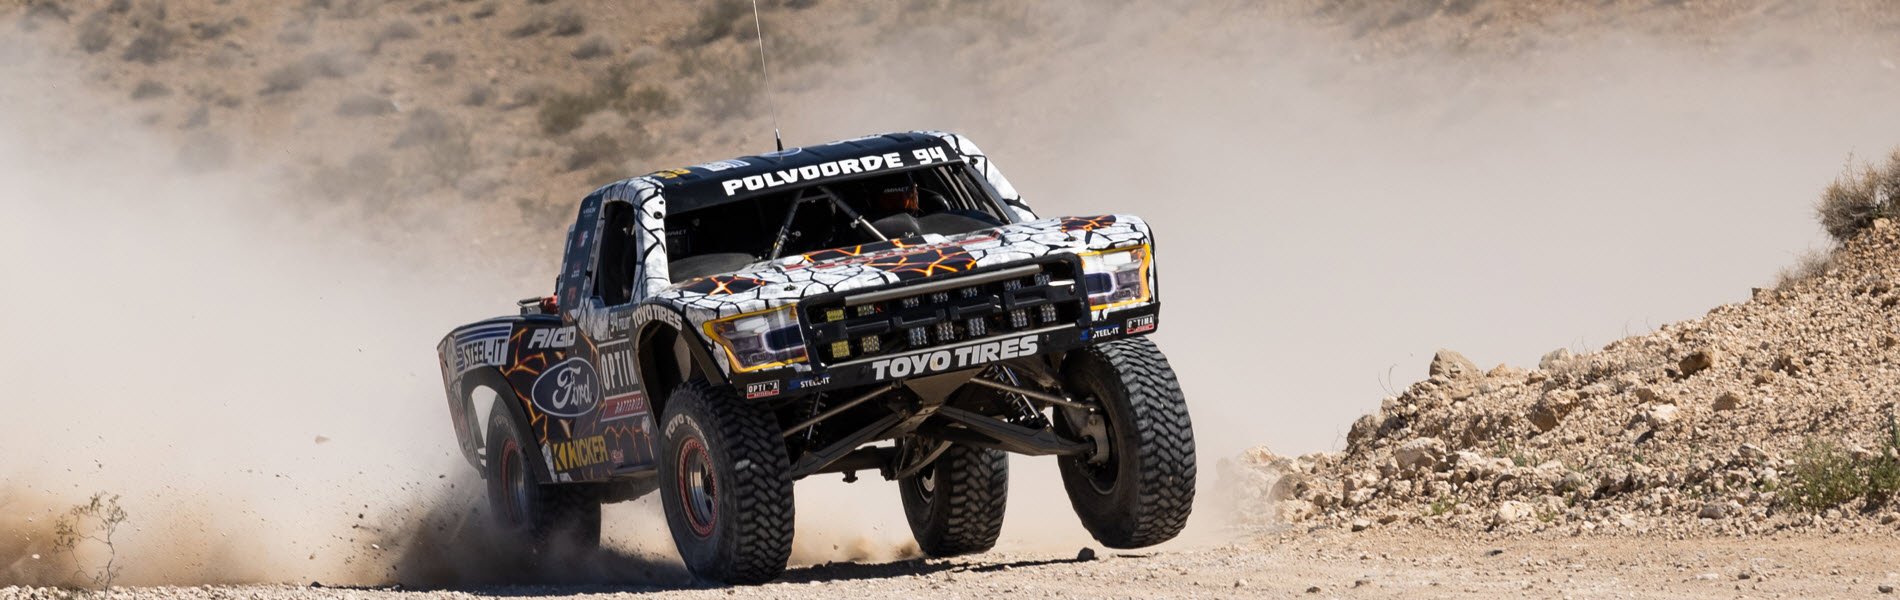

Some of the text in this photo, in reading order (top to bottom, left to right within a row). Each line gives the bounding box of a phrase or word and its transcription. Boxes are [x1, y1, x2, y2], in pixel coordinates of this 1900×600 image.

[722, 146, 949, 197] POLVOORDE 94
[632, 303, 683, 332] TOYO TIRES
[463, 338, 507, 367] STEEL-IT
[601, 349, 639, 391] OPTIM
[872, 334, 1039, 381] TOYO TIRES
[552, 366, 593, 409] Ford
[665, 413, 685, 440] TOYO
[567, 435, 609, 470] KICKER
